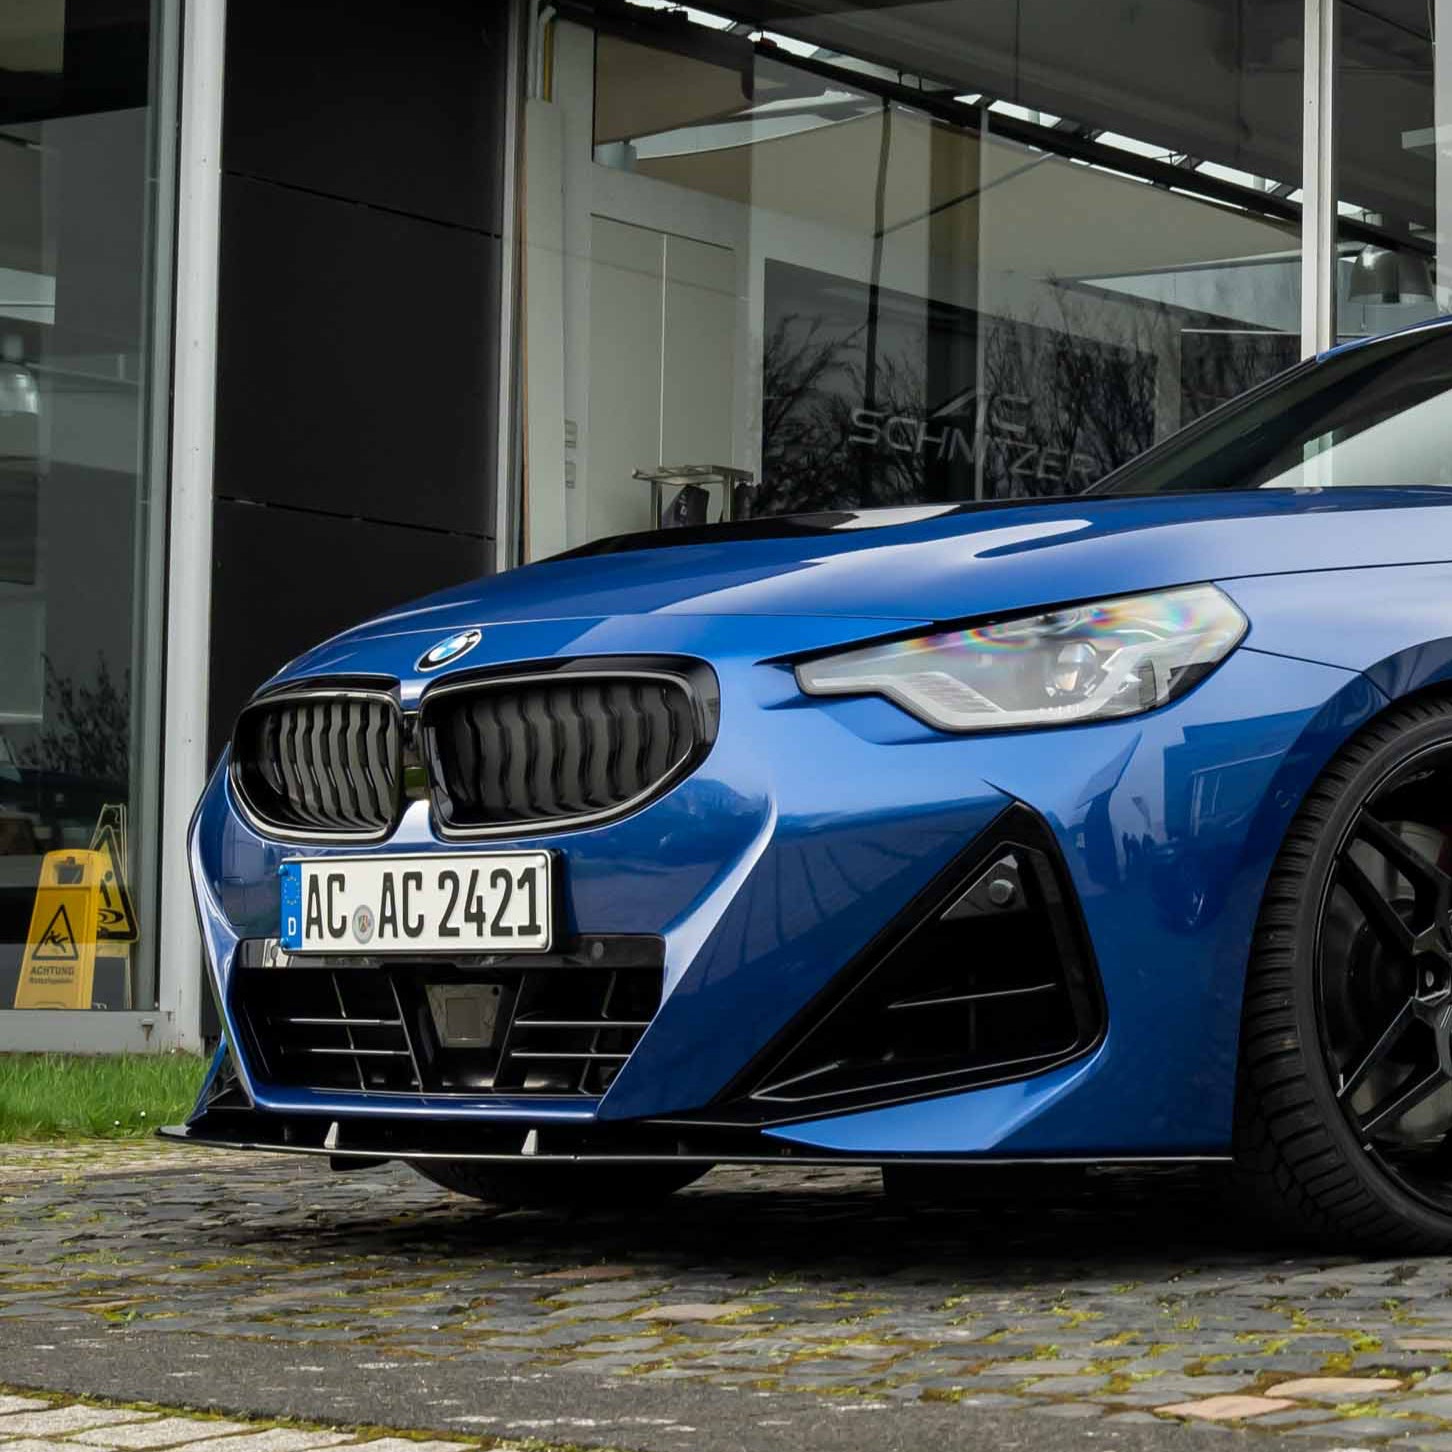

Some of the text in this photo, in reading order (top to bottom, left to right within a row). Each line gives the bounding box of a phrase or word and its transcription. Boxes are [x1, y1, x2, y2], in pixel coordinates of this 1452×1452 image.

[305, 866, 542, 939] AC AC 2421
[287, 917, 297, 936] D
[29, 965, 75, 976] ACHTUNG
